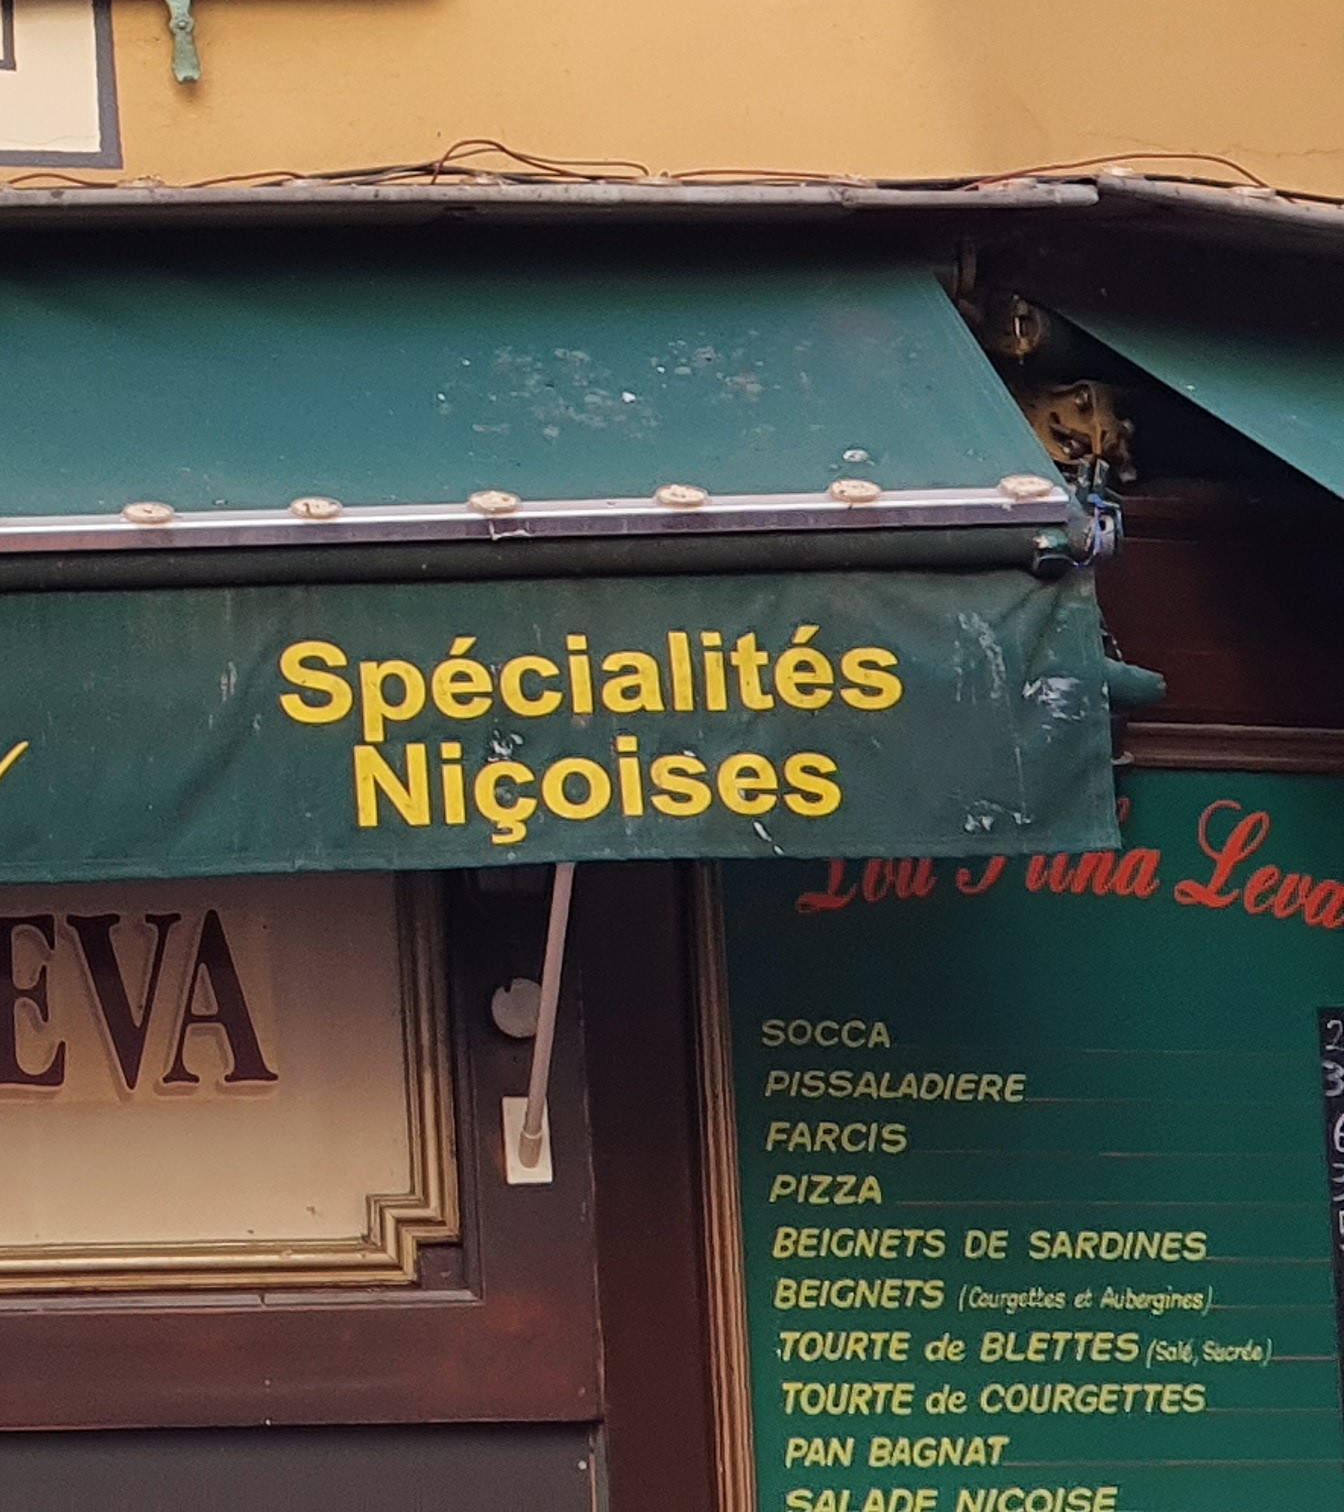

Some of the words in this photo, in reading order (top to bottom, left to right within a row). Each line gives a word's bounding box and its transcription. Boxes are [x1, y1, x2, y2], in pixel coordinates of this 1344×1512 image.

[279, 624, 903, 741] Spécialités
[353, 735, 842, 844] Niçoises
[761, 1019, 891, 1048] SOCCA
[765, 1070, 1027, 1103] PISSALADIERE
[765, 1121, 908, 1153] FARCIS
[768, 1174, 882, 1205] PIZZA
[772, 1226, 946, 1259] BEIGNETS
[964, 1229, 1009, 1259] DE
[1029, 1230, 1208, 1261] SARDINES
[774, 1278, 945, 1309] BEIGNETS
[958, 1284, 1066, 1315] (Courgettes
[1073, 1287, 1093, 1308] et
[1100, 1285, 1213, 1316] Aubergines)
[779, 1331, 912, 1362] TOURTE
[924, 1332, 966, 1361] de
[980, 1331, 1139, 1361] BLETTES
[782, 1382, 915, 1415] TOURTE
[925, 1384, 968, 1414] de
[980, 1383, 1207, 1414] COURGETTES
[784, 1436, 855, 1469] PAN
[868, 1435, 1010, 1468] BAGNAT
[785, 1487, 938, 1512] SALADE
